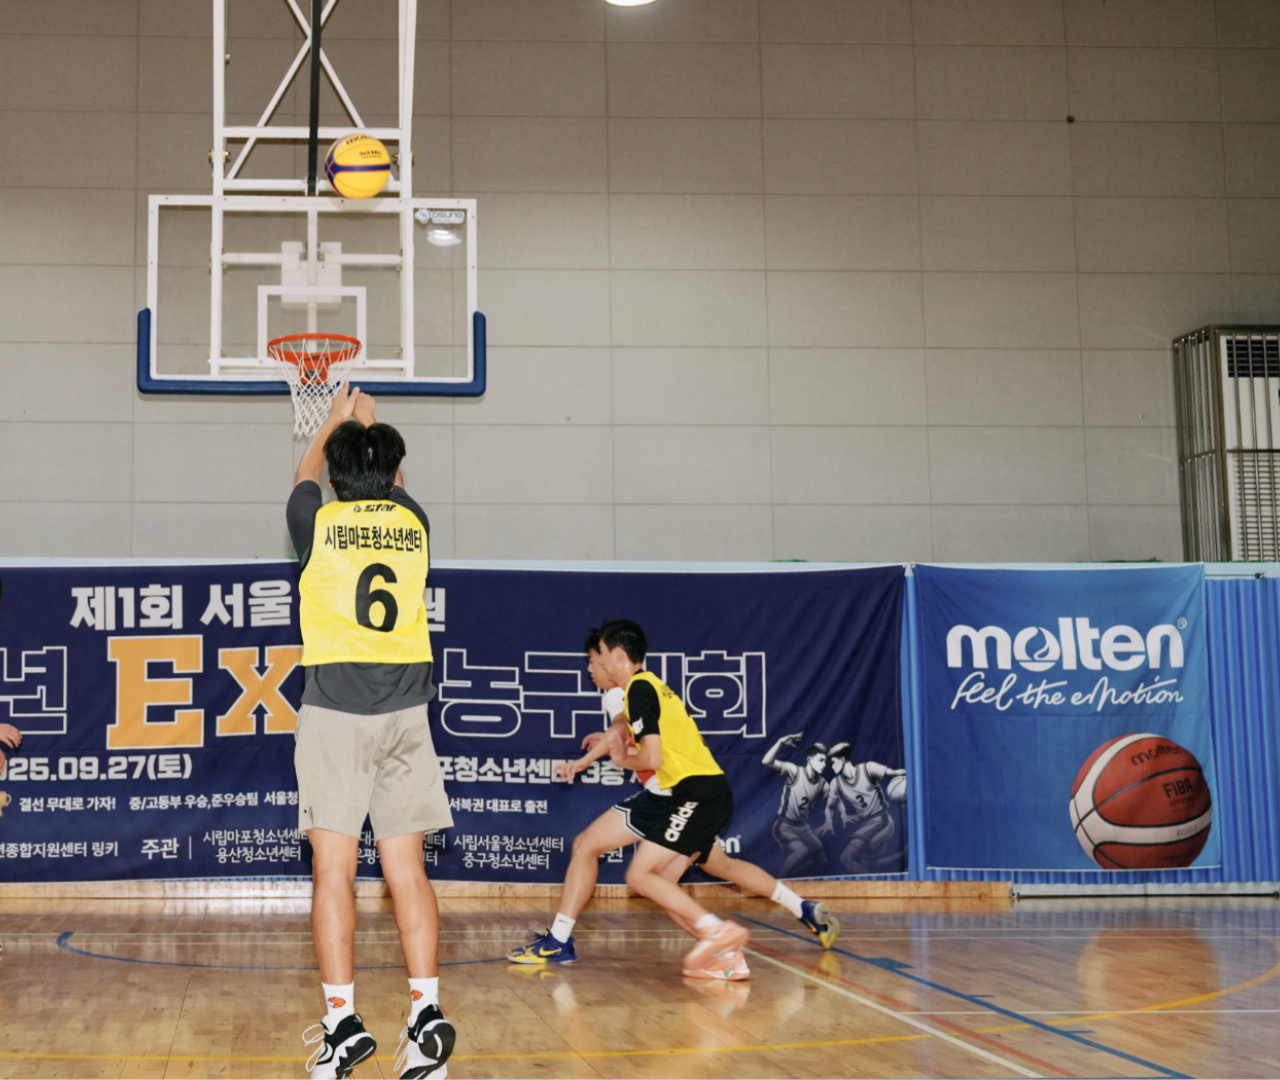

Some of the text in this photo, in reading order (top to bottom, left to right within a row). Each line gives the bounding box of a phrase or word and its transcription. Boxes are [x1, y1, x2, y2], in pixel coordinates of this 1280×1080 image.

[325, 524, 423, 553] 시립마포청소년센터
[70, 579, 292, 631] 제1회 서울
[355, 562, 399, 633] 6
[946, 617, 1184, 672] molten
[106, 635, 306, 749] Ex
[951, 671, 1017, 711] feel
[1016, 679, 1068, 709] the
[437, 756, 574, 785] 포청소년센터
[1163, 778, 1194, 799] FIBA
[19, 791, 299, 812] 결선 무대로 가자! 중/고등부 우승,준우승팀 서울청
[486, 798, 523, 813] 대표로
[524, 799, 549, 814] 출전
[91, 841, 119, 857] 링키
[141, 838, 180, 860] 주관
[215, 846, 302, 864] 용산청소년센터
[453, 835, 565, 853] 시립서울청소년센터
[462, 851, 550, 870] 중구청소년센터
